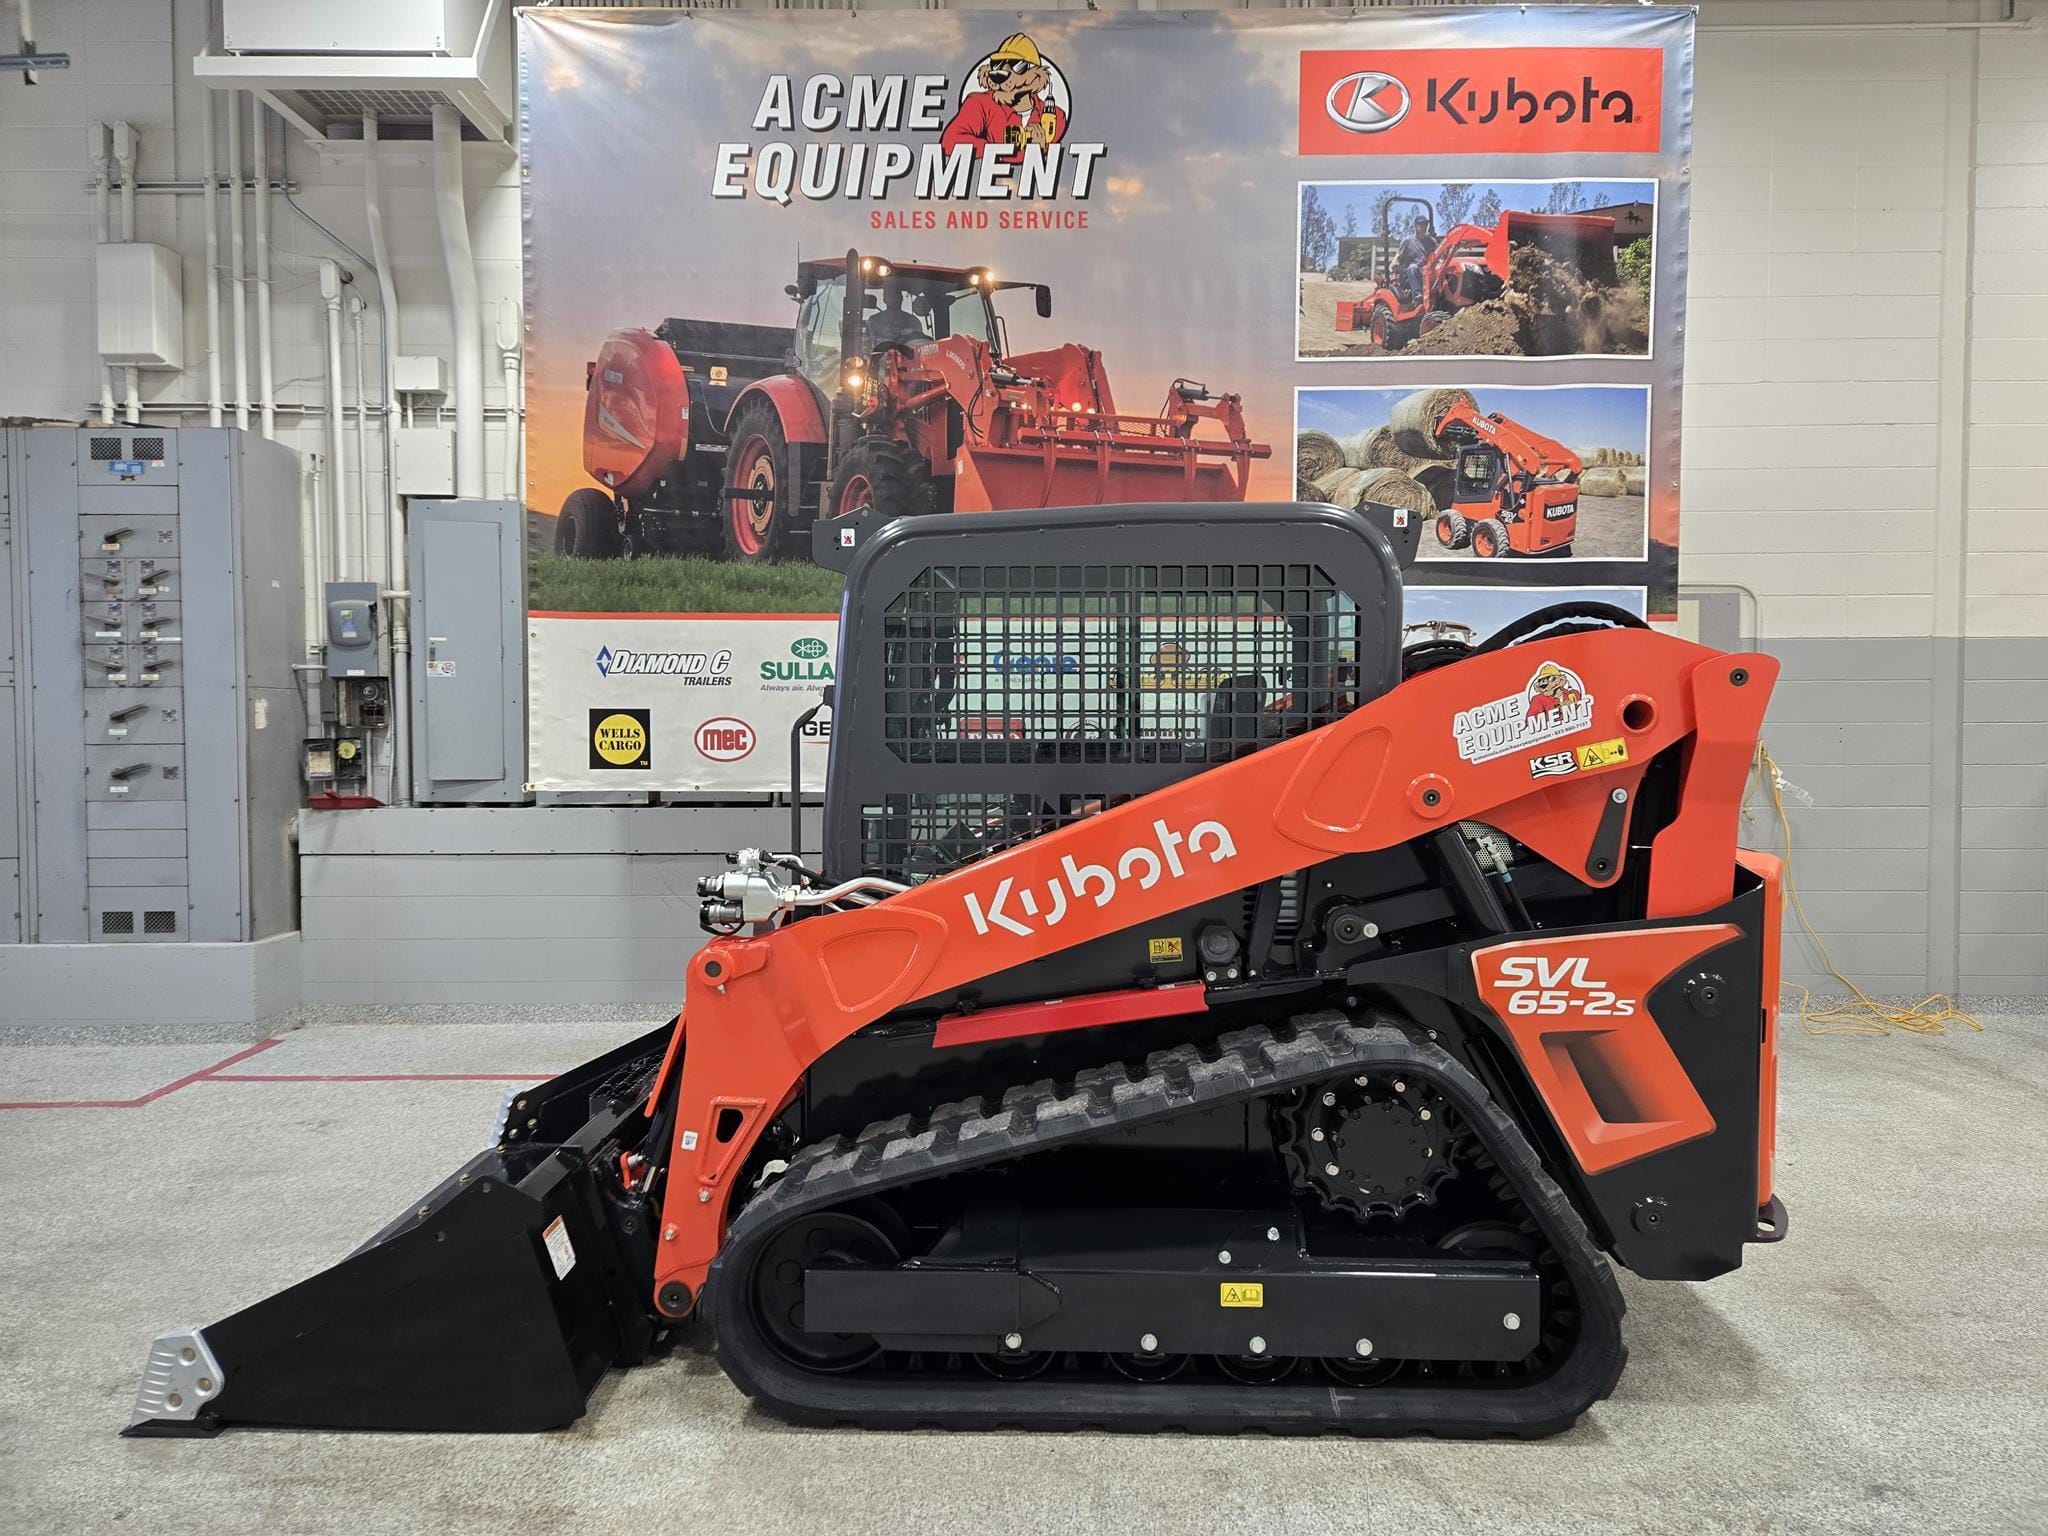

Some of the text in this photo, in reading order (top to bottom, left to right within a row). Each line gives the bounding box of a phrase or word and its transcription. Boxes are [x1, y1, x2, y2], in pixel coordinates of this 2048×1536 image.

[752, 74, 949, 131] ACME
[1426, 77, 1634, 124] Kubota
[711, 142, 1108, 207] EQUIPMENT
[870, 210, 1089, 230] SALES AND SERVICE
[1472, 416, 1497, 435] KUBOTA
[1546, 504, 1575, 518] KUBOTA
[608, 650, 732, 675] DIAMOND C
[760, 661, 835, 681] SULLA
[683, 677, 732, 686] TRAILERS
[760, 684, 789, 692] Always
[1456, 697, 1520, 735] ACME
[600, 728, 641, 739] WELLS
[802, 721, 831, 736] GE
[1461, 699, 1591, 756] EQUIPMENT
[599, 740, 642, 751] CARGO
[1529, 752, 1574, 772] KSR
[963, 819, 1237, 937] Kubota
[1494, 957, 1607, 988] SVL
